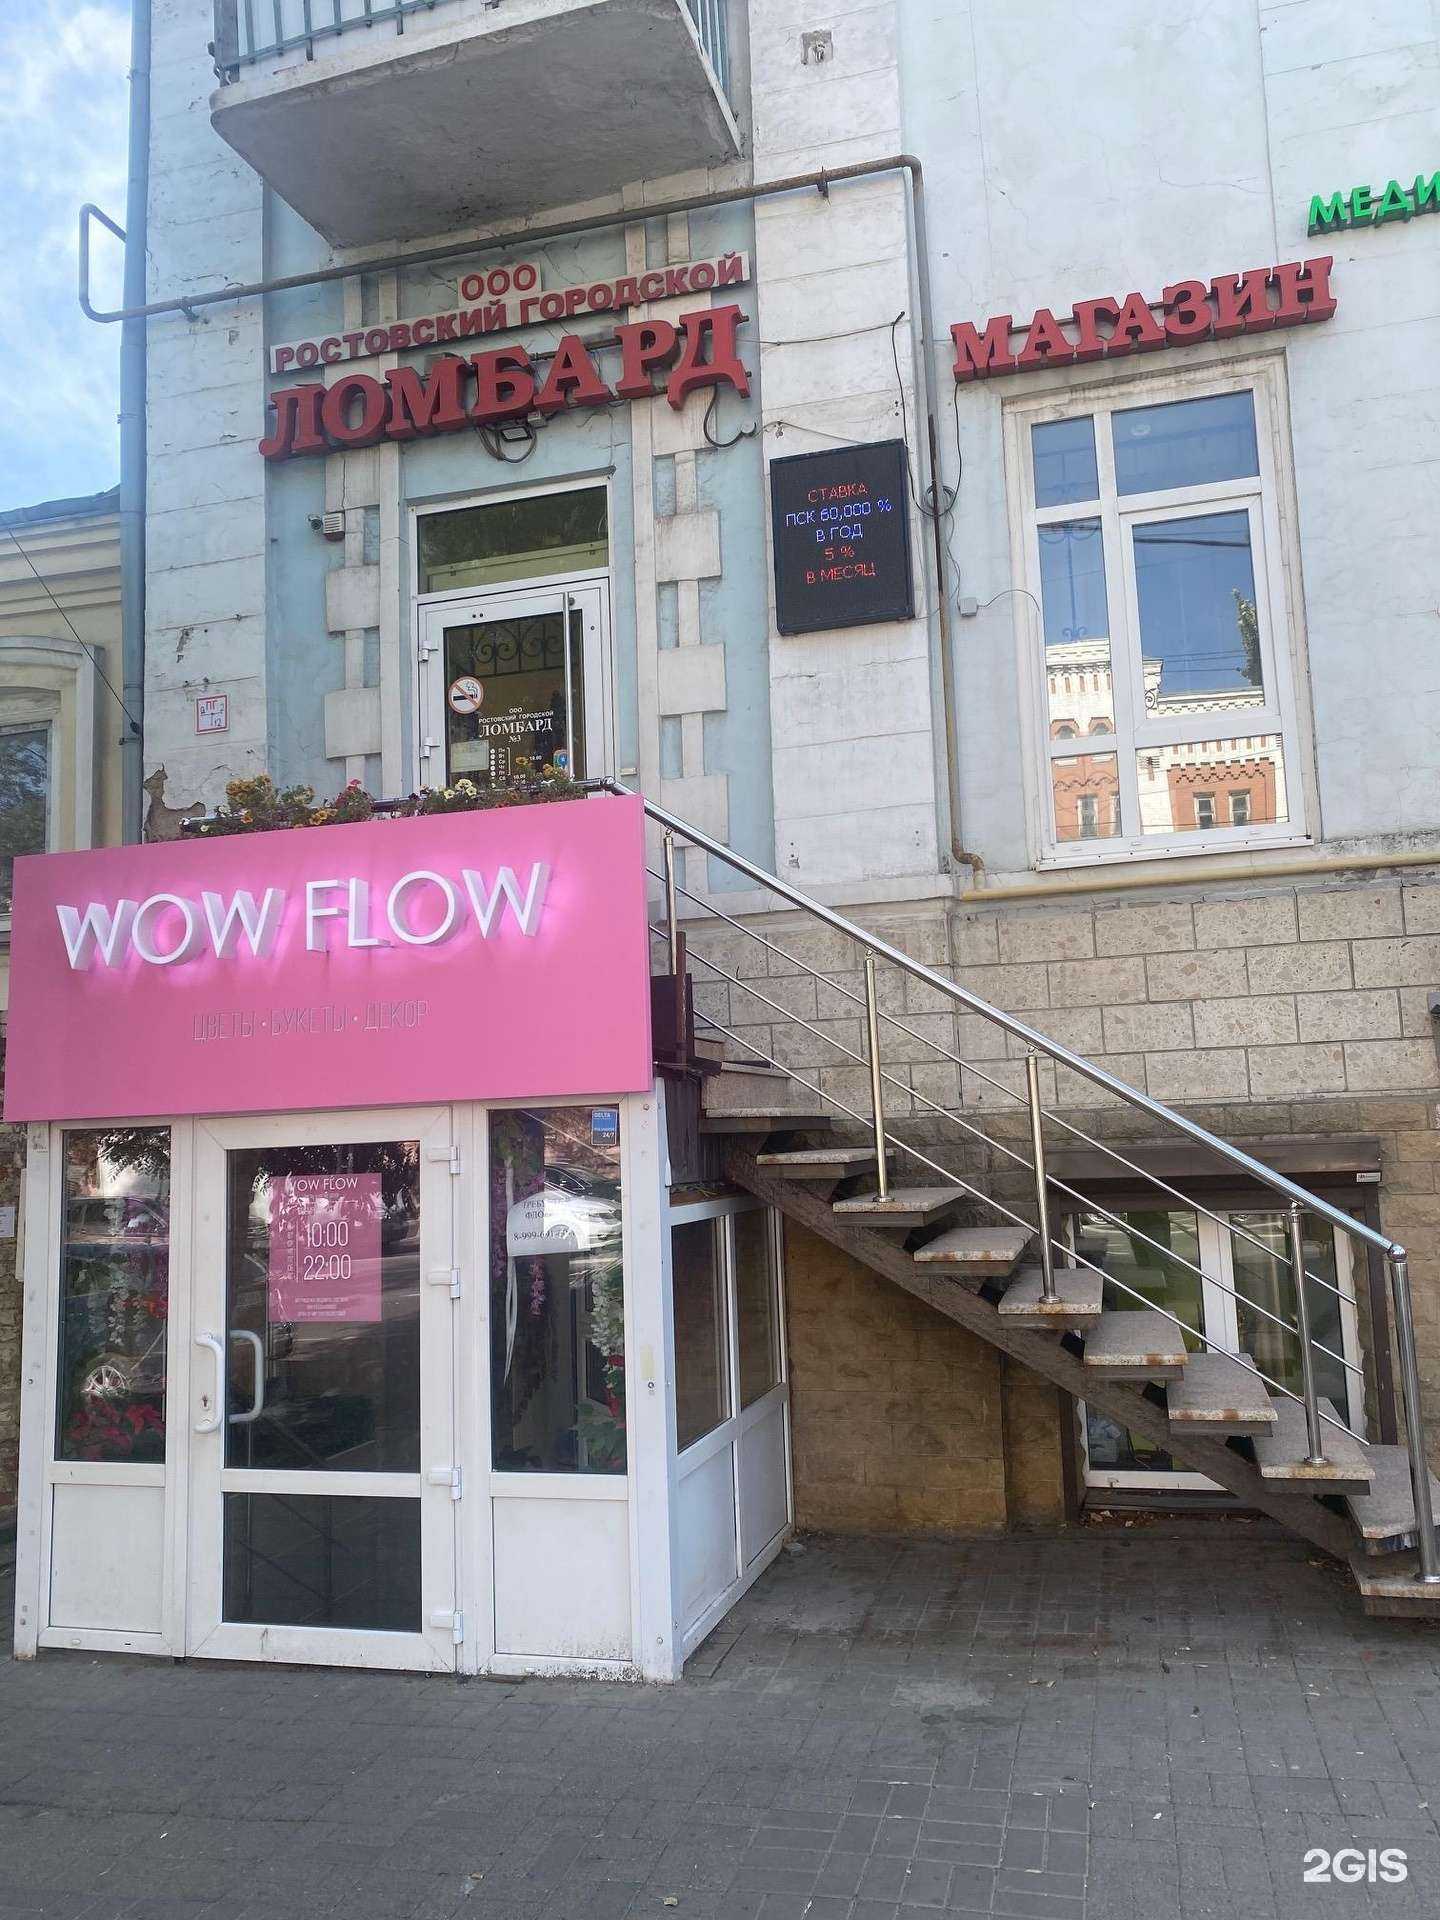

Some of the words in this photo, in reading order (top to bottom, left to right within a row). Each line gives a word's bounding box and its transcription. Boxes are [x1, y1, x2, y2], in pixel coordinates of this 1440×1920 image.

[1307, 170, 1440, 236] МЕДИ
[461, 264, 537, 301] ООО
[275, 301, 508, 373] РОСТОВСКИЙ
[519, 250, 745, 325] ГОРОДСКОЙ
[950, 255, 1338, 382] МАГАЗИН
[259, 305, 752, 462] ЛОМБАРД
[807, 482, 868, 502] СТАВКА
[786, 509, 816, 527] ПСК
[820, 502, 872, 522] 60,000
[877, 498, 893, 513] %
[816, 529, 826, 542] В
[830, 523, 864, 540] ГОД
[824, 548, 834, 561] 5
[840, 545, 856, 558] %
[806, 571, 815, 584] В
[820, 562, 877, 582] МЕСЯЦ
[479, 715, 517, 724] РОСТОВСКИЙ
[519, 710, 554, 719] ГОРОДСКОЙ
[479, 718, 553, 737] ЛОМБАРД
[55, 887, 285, 971] WOW
[304, 861, 552, 954] FLOW
[362, 999, 428, 1033] ДЕКОР
[323, 1177, 358, 1190] FLOW
[306, 1221, 349, 1248] 10:00
[303, 1254, 351, 1281] 22:00
